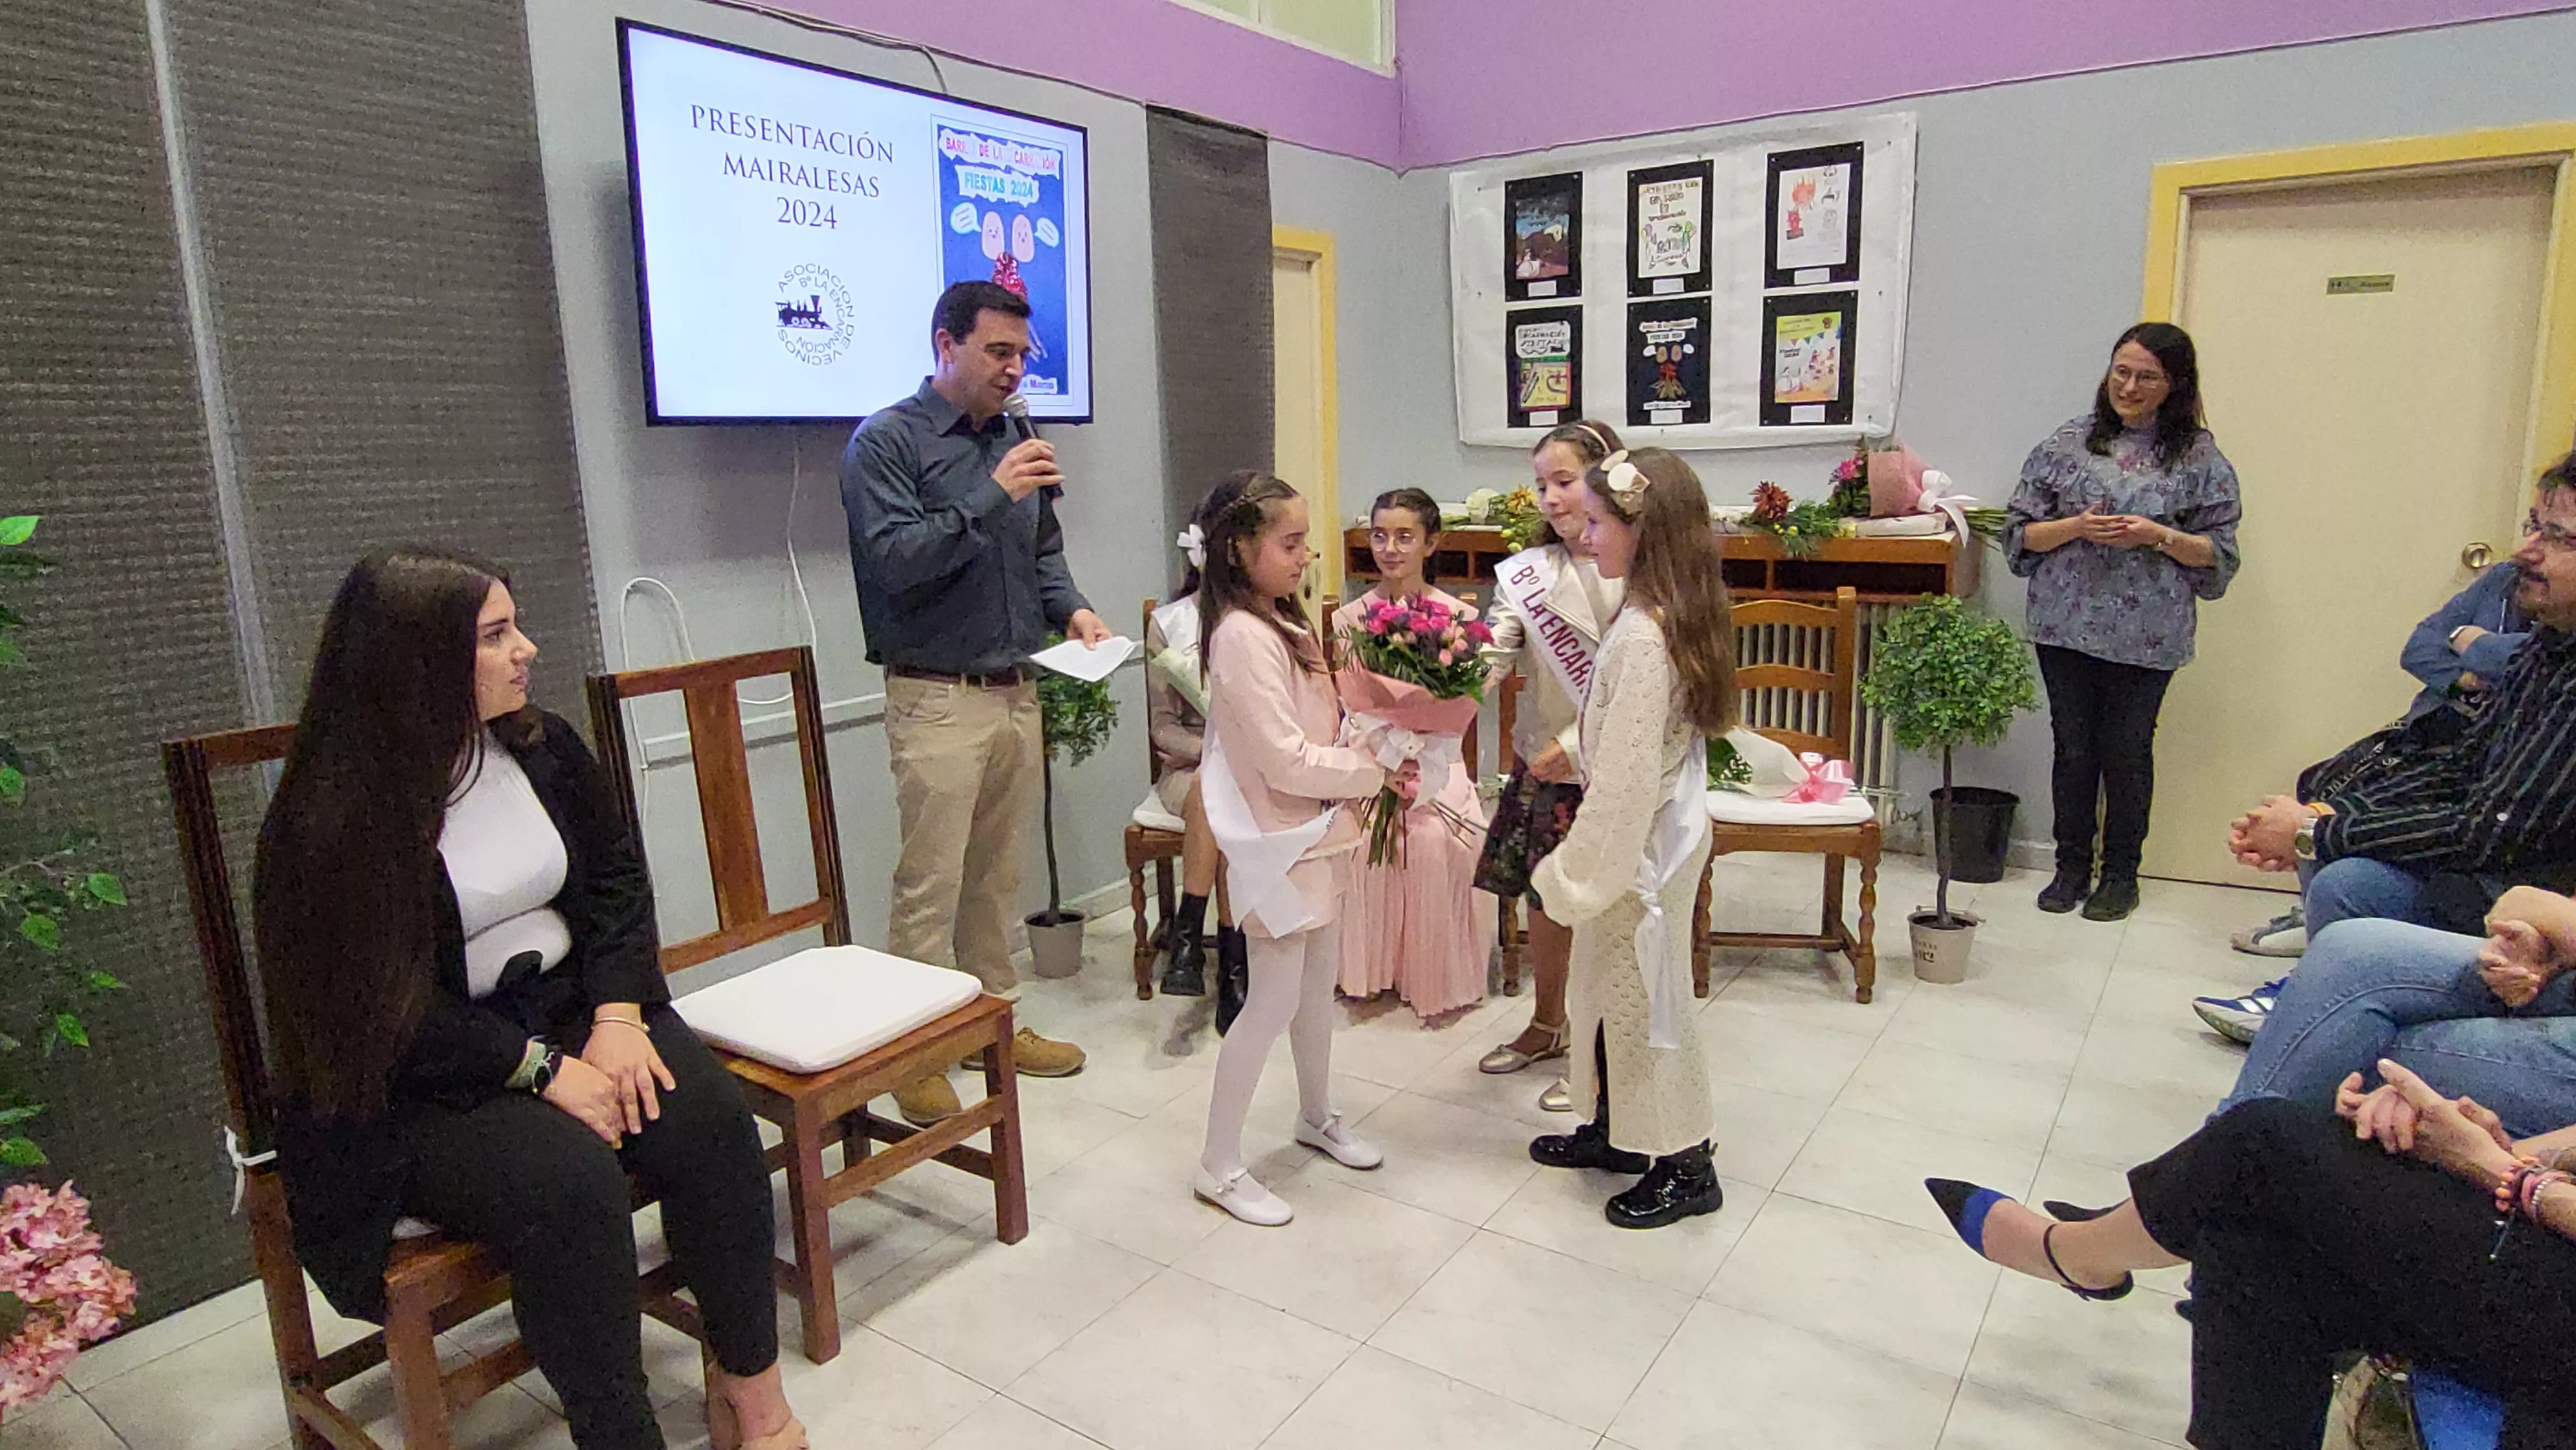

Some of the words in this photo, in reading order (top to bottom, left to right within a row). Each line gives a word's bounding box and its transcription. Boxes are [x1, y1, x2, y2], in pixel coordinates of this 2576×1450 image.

[689, 103, 894, 164] PRESENTACIÓN
[723, 151, 880, 198] MAIRALESAS
[964, 171, 1005, 194] FIESTAS
[1010, 179, 1034, 198] 2024
[777, 196, 838, 230] 2024
[815, 276, 828, 292] LA
[777, 329, 843, 366] VECINOS
[840, 324, 855, 350] DE
[1522, 587, 1547, 620] LA
